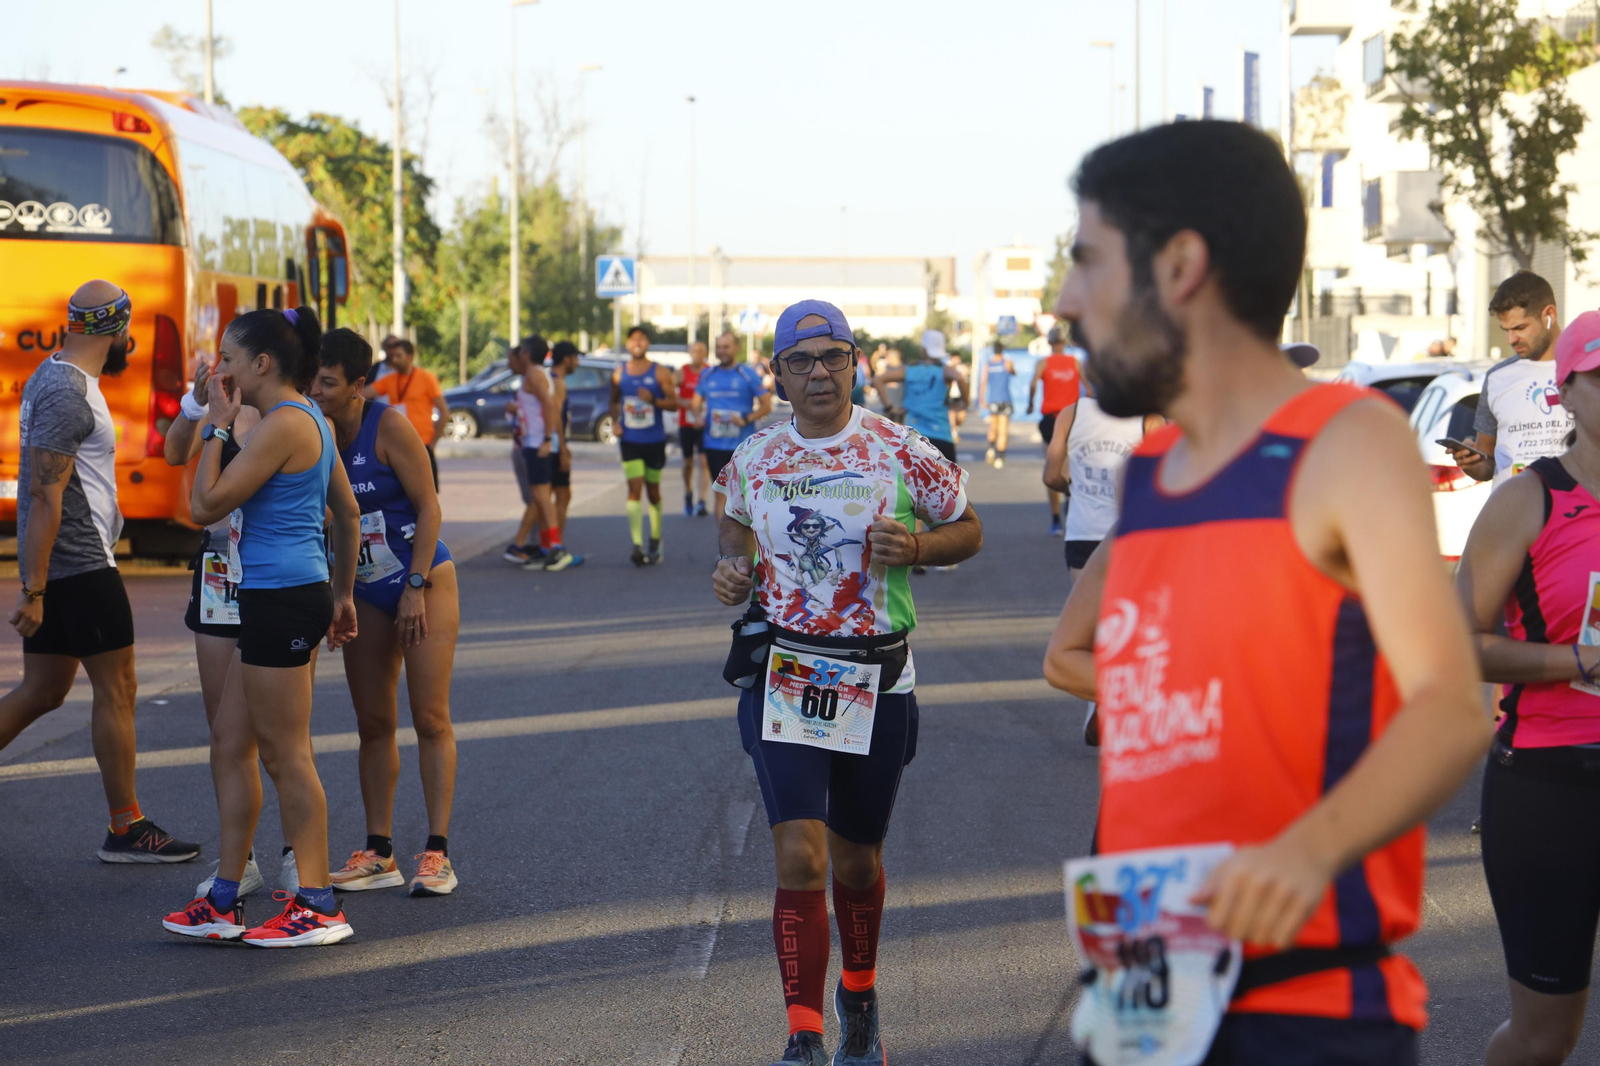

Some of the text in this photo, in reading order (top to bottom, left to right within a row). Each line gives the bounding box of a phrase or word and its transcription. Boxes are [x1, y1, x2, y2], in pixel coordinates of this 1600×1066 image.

[1545, 420, 1562, 428] DEL
[351, 480, 376, 494] RRA
[801, 685, 839, 721] 60
